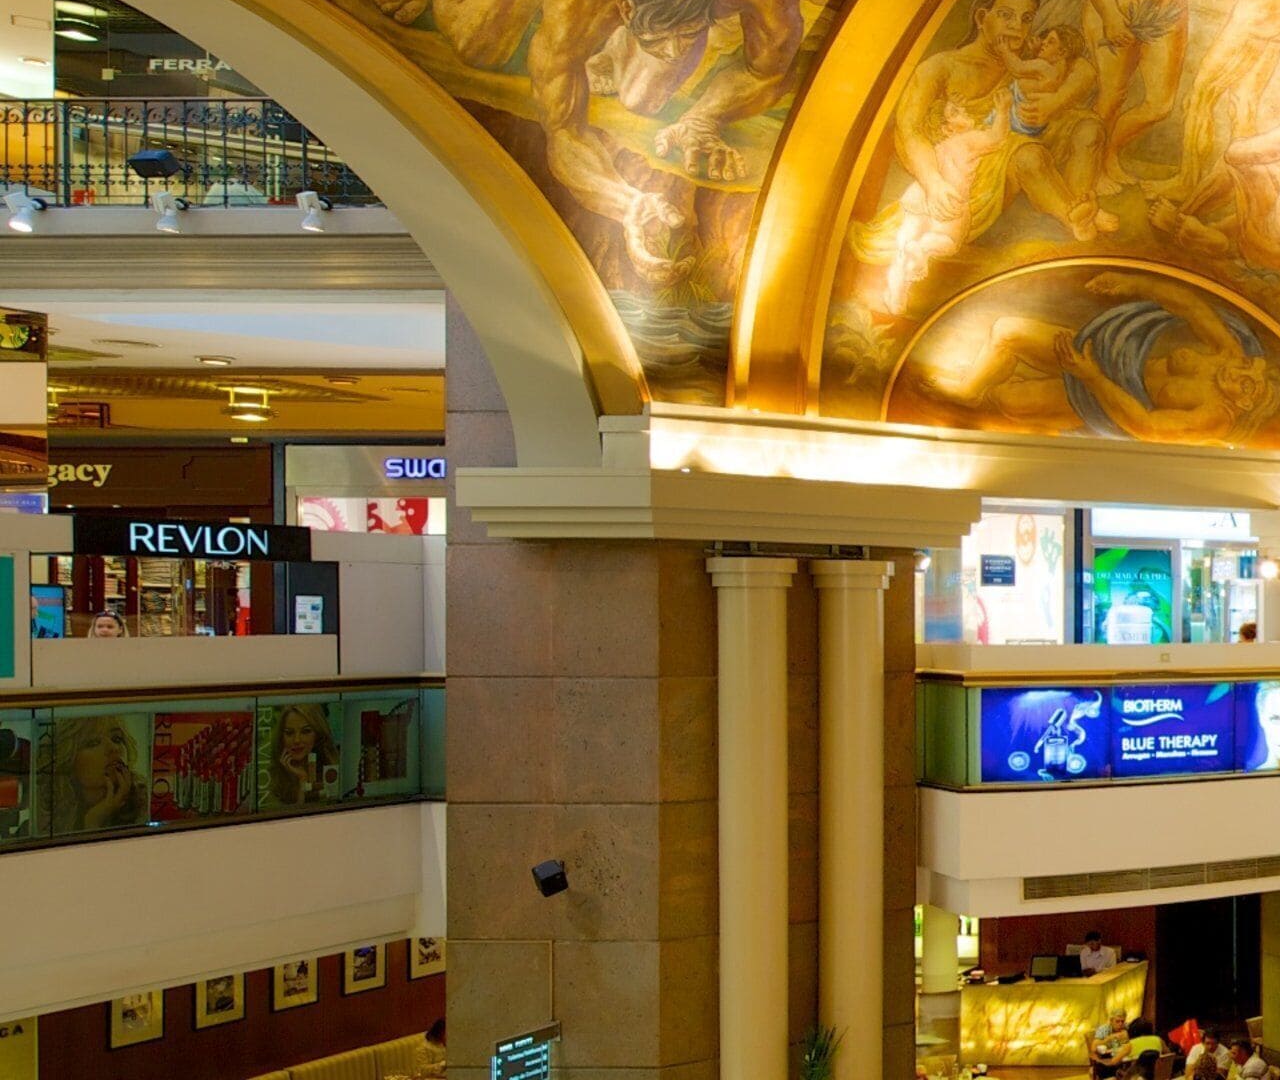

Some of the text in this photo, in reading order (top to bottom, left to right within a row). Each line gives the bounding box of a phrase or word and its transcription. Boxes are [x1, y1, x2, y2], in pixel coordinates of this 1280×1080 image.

[386, 458, 446, 478] swa
[129, 522, 269, 556] REVLON
[1123, 699, 1183, 713] BIOTHERM
[1122, 734, 1218, 751] BLUE THERAPY
